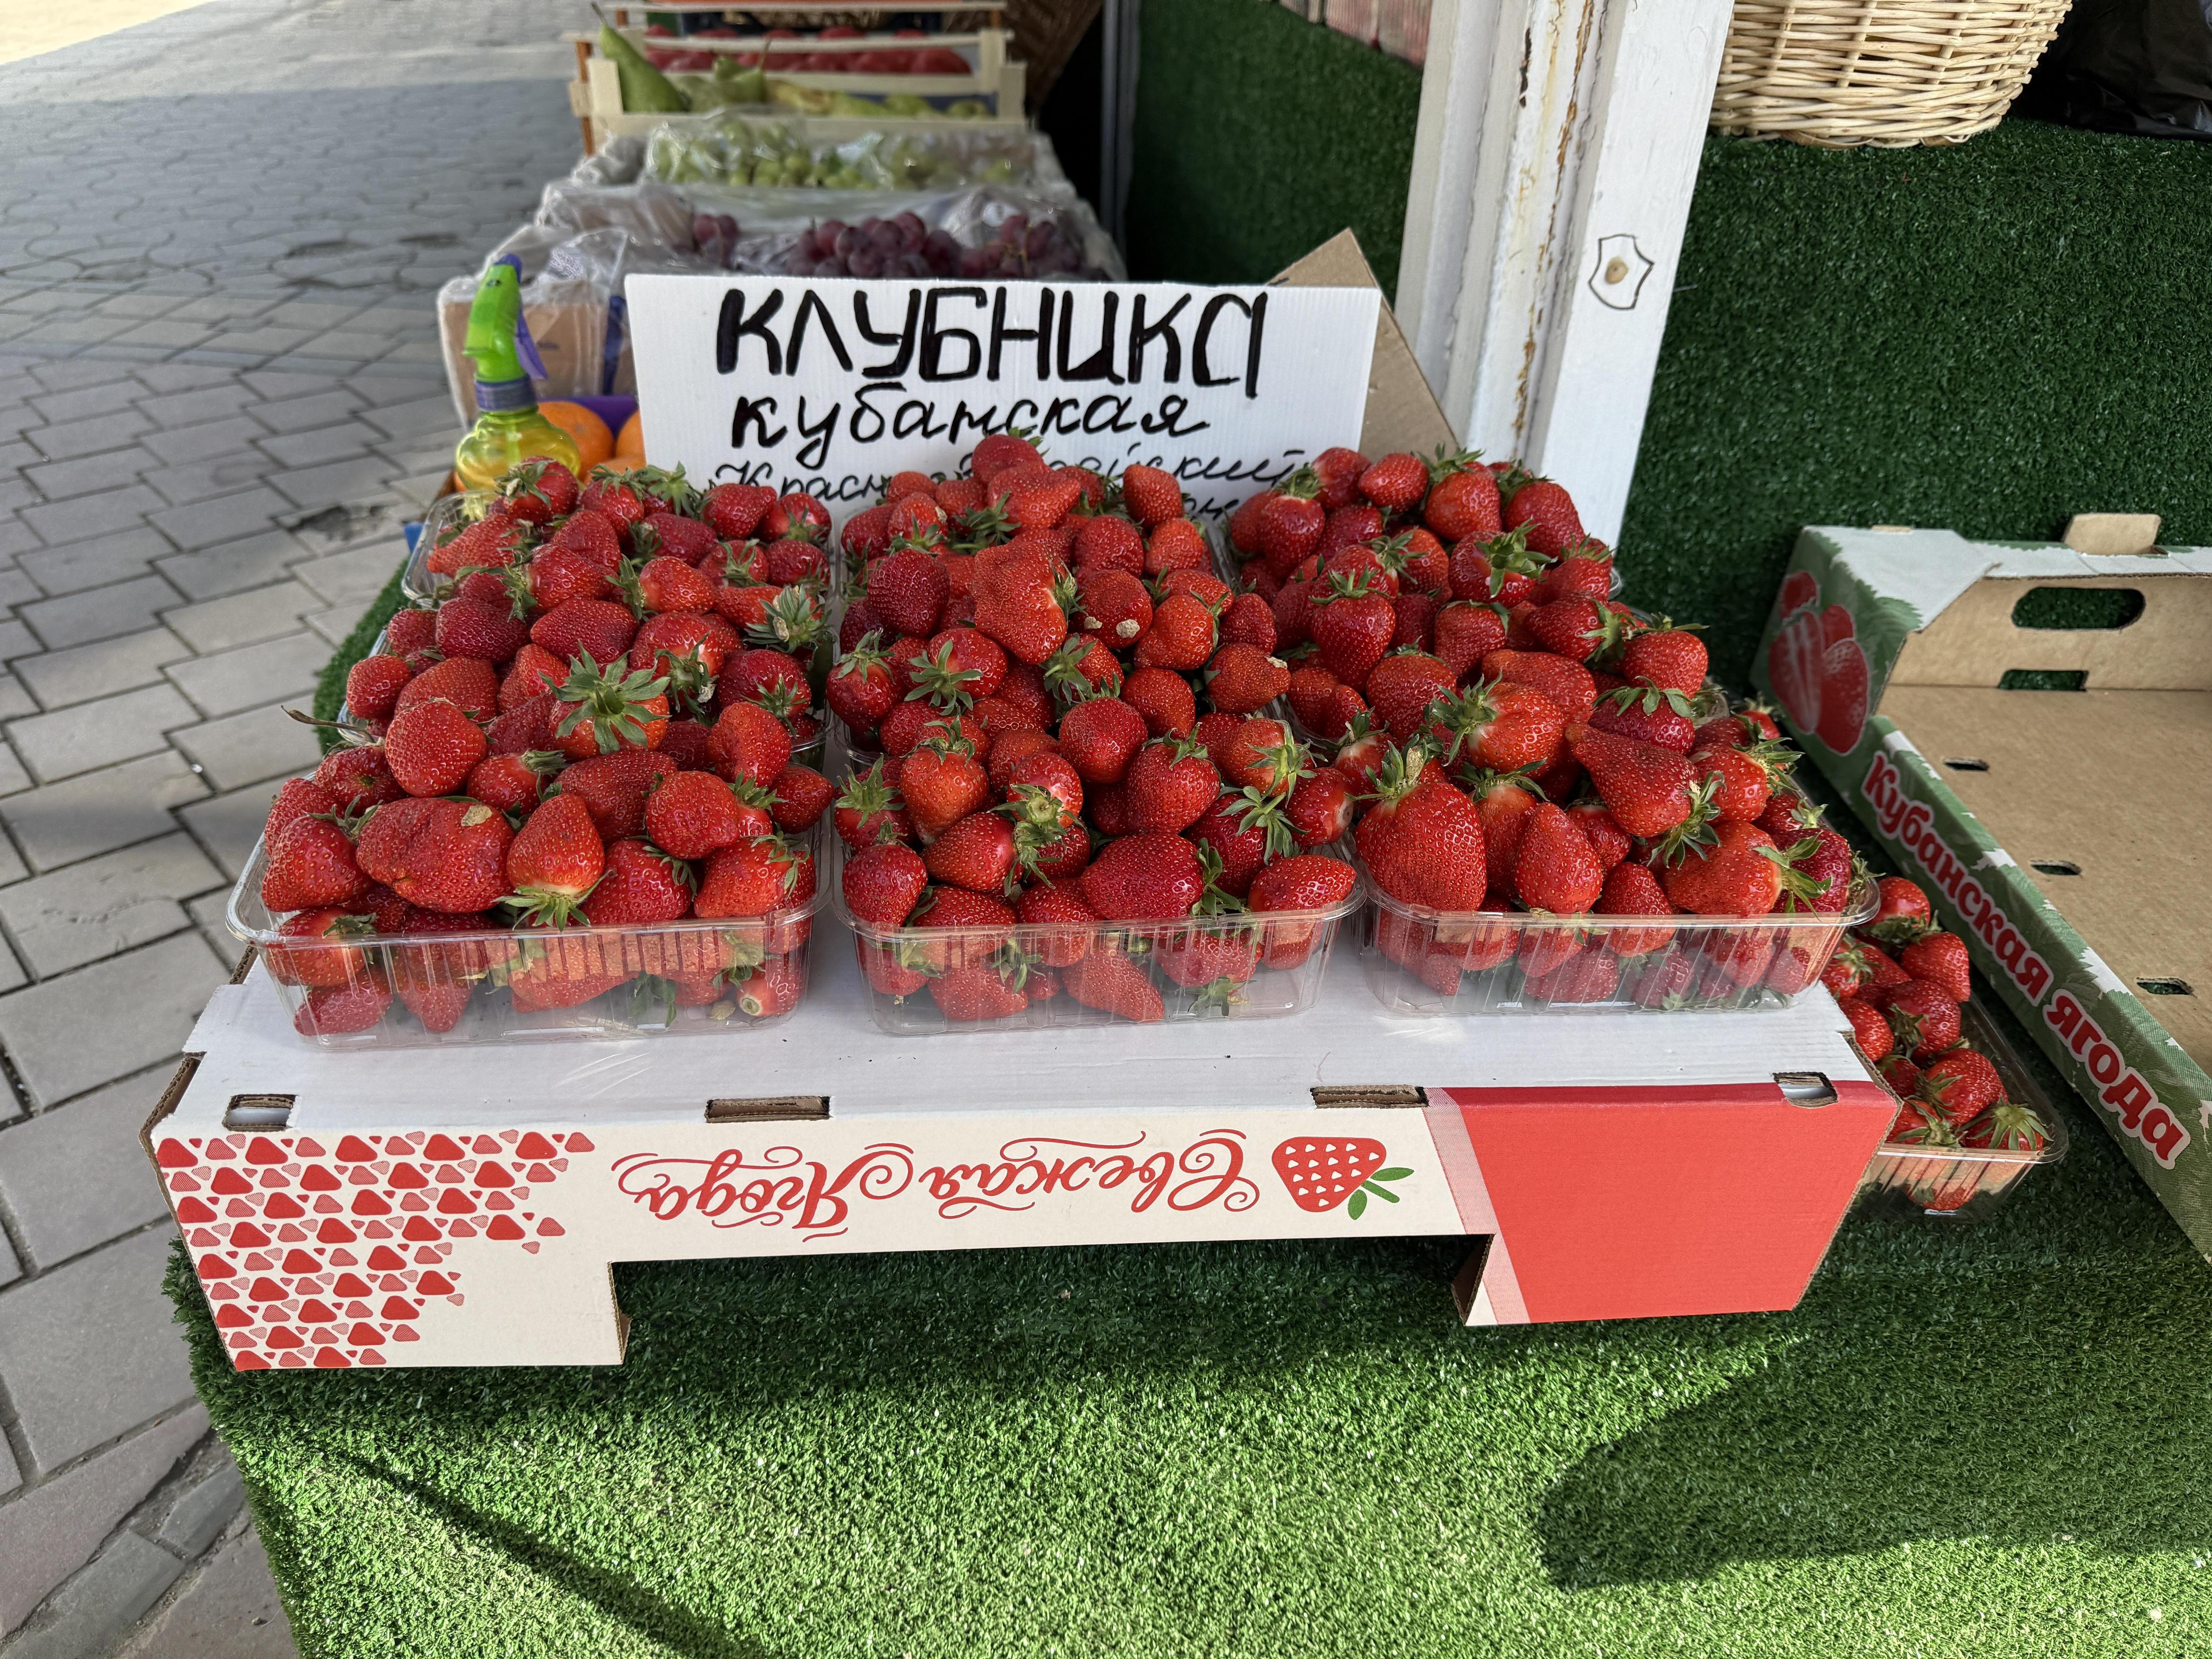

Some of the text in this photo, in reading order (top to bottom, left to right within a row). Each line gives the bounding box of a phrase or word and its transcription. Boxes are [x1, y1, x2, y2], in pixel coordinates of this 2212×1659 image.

[717, 285, 1268, 399] КЛУБНИКА
[1864, 753, 2183, 1161] Кубанская ягода
[611, 1129, 1260, 1242] Свежая Ягода
